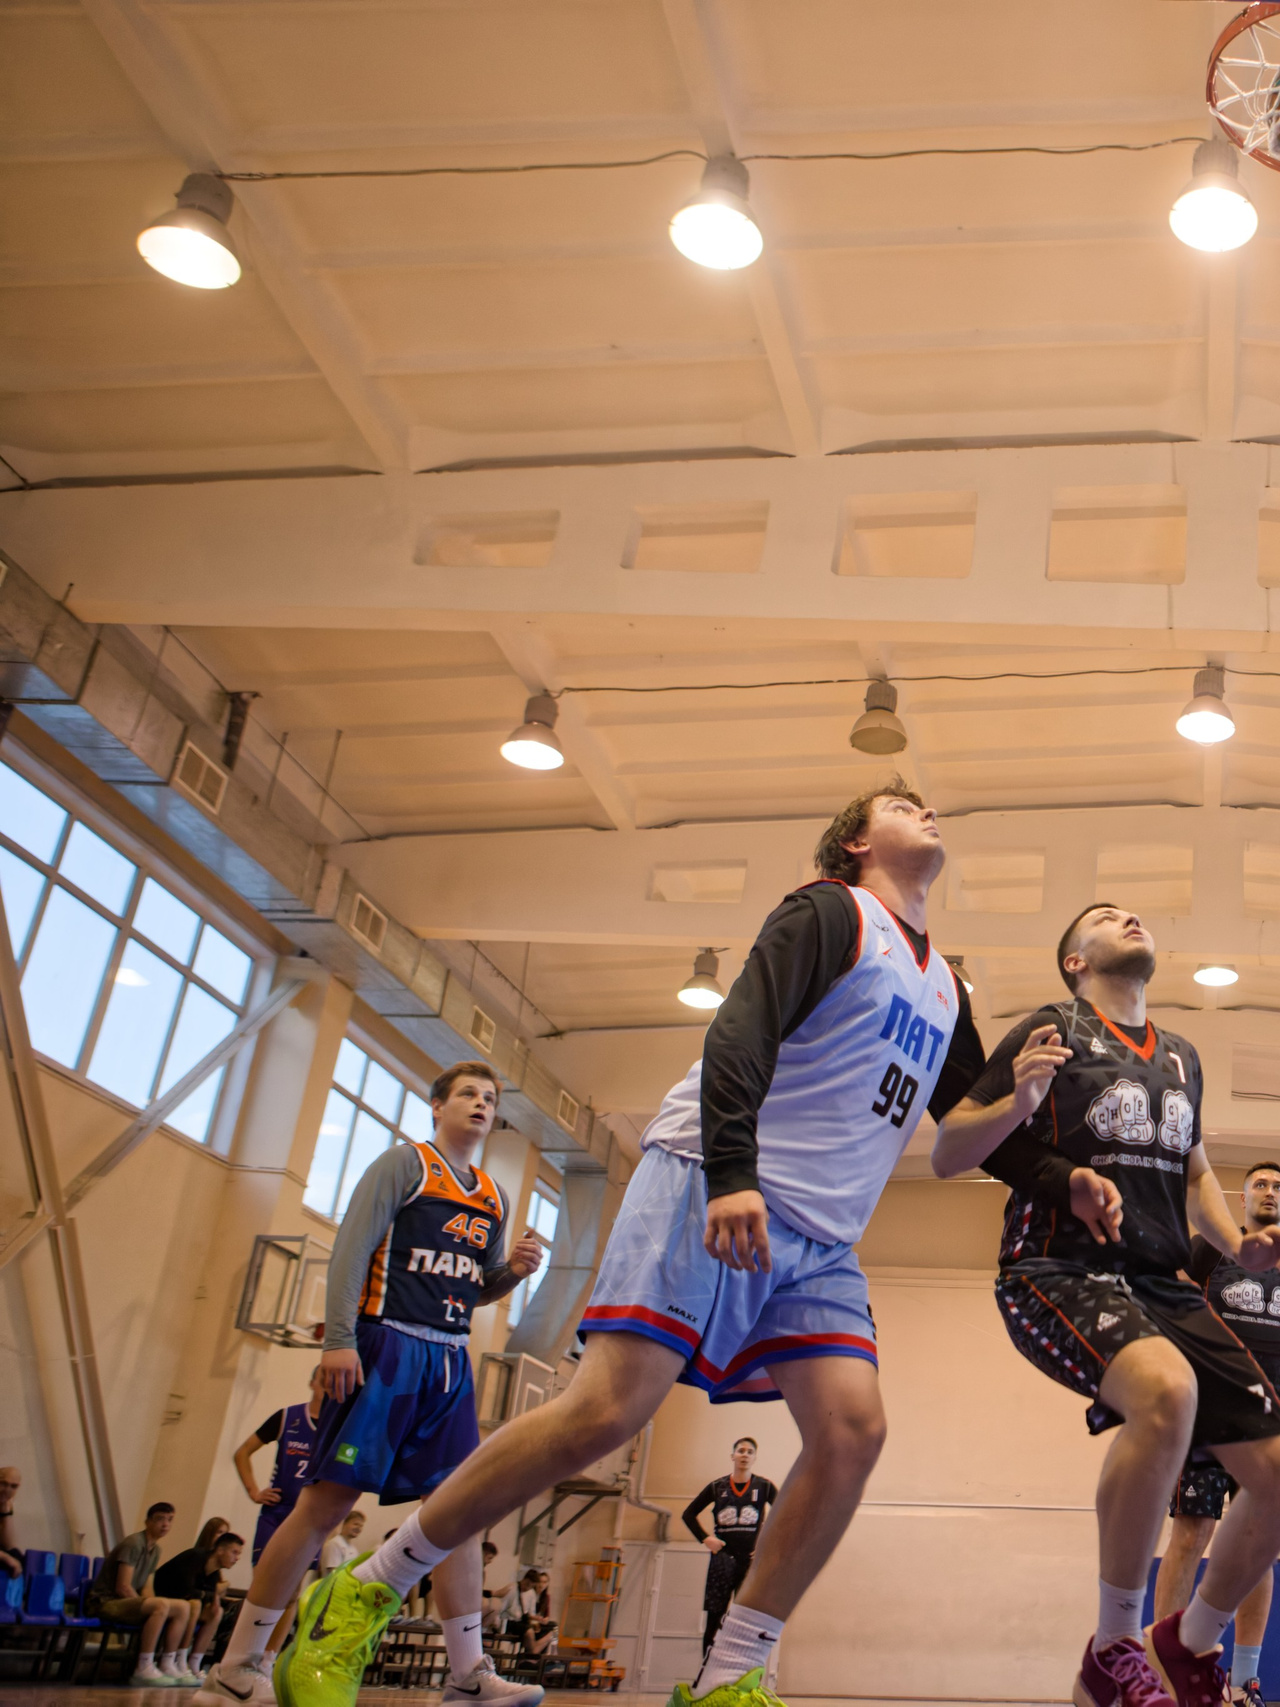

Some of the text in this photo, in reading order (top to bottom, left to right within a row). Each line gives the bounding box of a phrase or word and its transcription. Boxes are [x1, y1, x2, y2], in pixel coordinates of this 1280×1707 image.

[879, 993, 945, 1073] ПАТ
[871, 1062, 919, 1129] 99
[442, 1213, 491, 1249] 46
